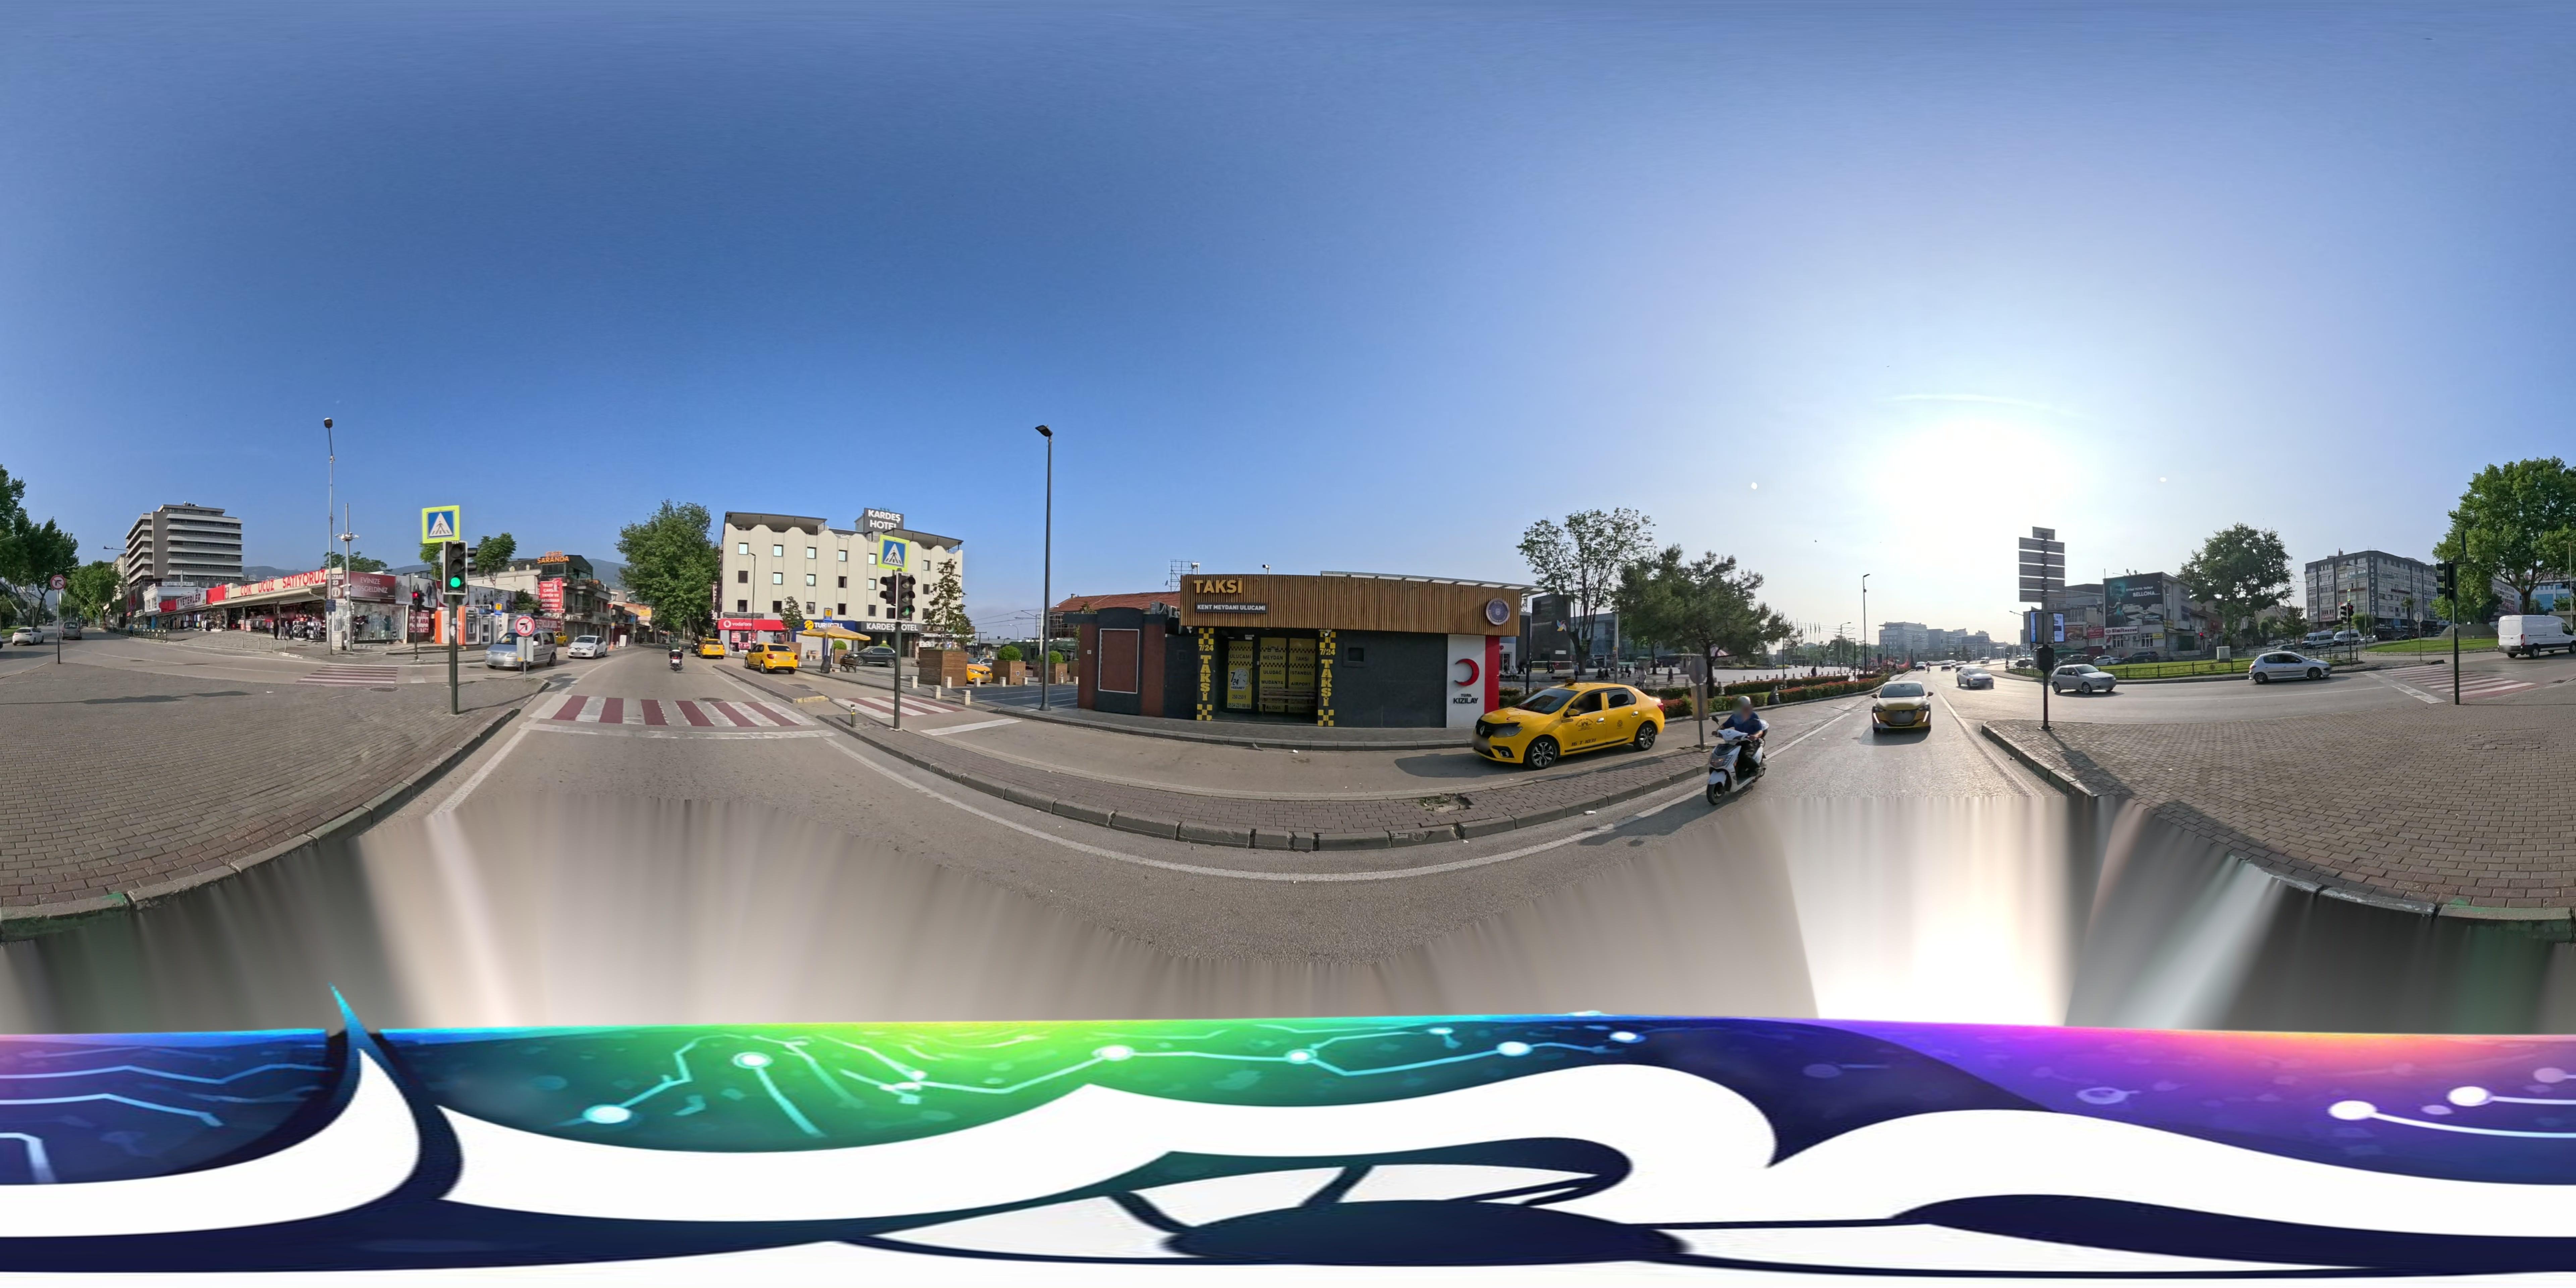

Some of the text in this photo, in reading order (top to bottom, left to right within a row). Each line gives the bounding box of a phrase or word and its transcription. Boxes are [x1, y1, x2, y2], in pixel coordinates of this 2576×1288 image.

[868, 509, 901, 523] KARDEŞ
[537, 555, 570, 564] SARANDA
[258, 579, 275, 593] UCUZ
[283, 569, 326, 589] SATIYORUZ
[360, 577, 381, 585] EVİNİZE
[1193, 578, 1242, 593] TAKSİ
[354, 585, 388, 593] OŞGELDİNİZ
[180, 593, 201, 606] YETERLER
[866, 623, 895, 632] KARDEŞ
[1231, 672, 1235, 683] 7
